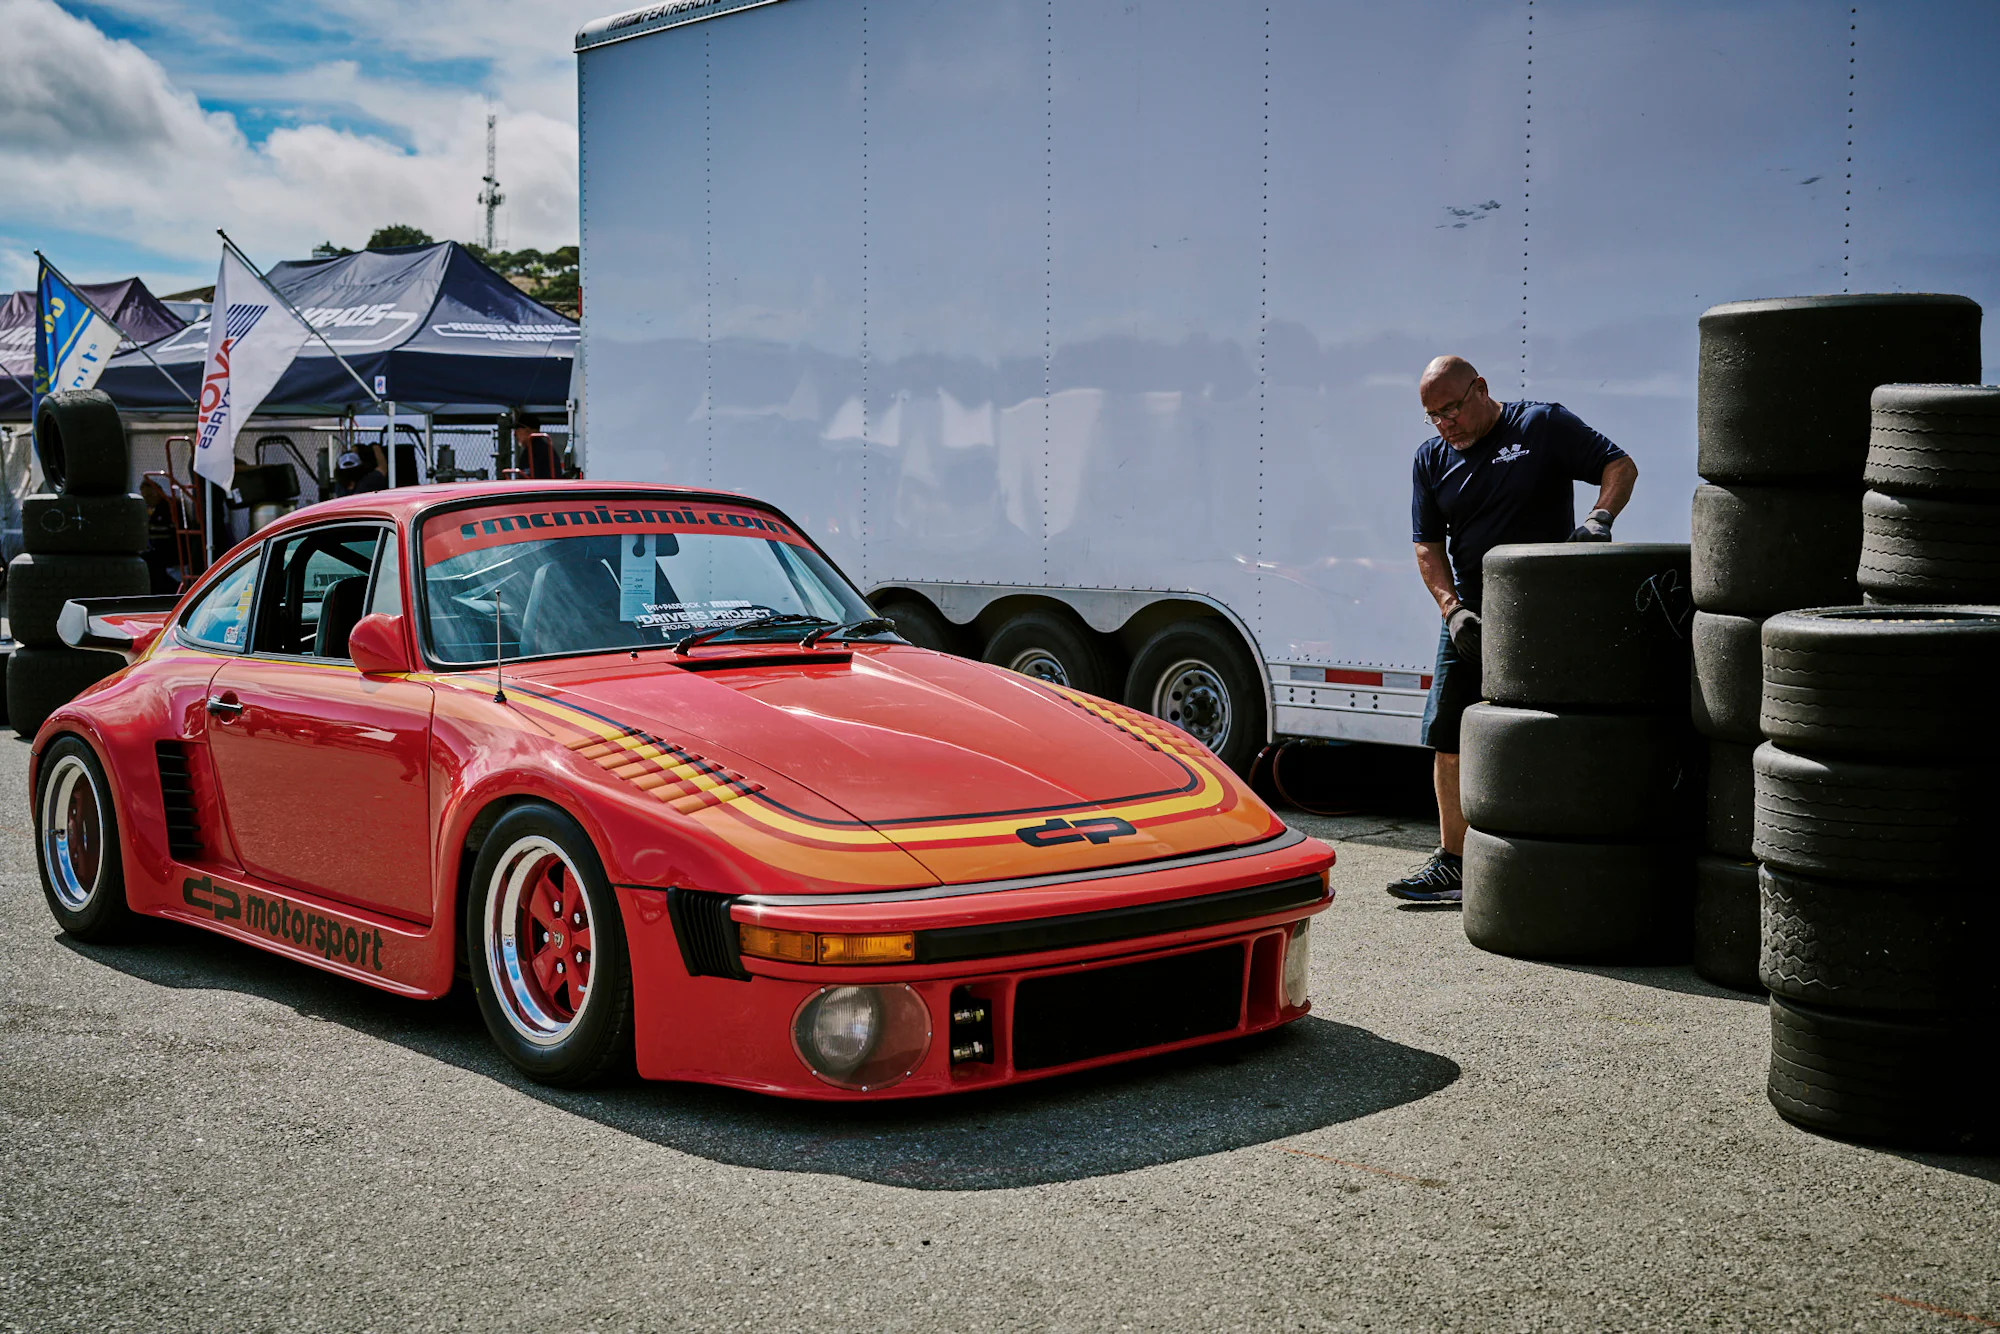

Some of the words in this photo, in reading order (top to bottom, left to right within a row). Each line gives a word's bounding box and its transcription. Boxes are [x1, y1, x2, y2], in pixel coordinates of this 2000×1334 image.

[448, 322, 510, 333] ROGER
[510, 324, 570, 333] KRAUS
[486, 333, 554, 342] RACING
[459, 505, 791, 539] rmcmiami.com
[640, 610, 708, 624] DRIVERS
[709, 608, 771, 620] PROJECT
[661, 623, 690, 632] ROAD
[691, 621, 706, 629] TO
[246, 893, 384, 972] motorsport
